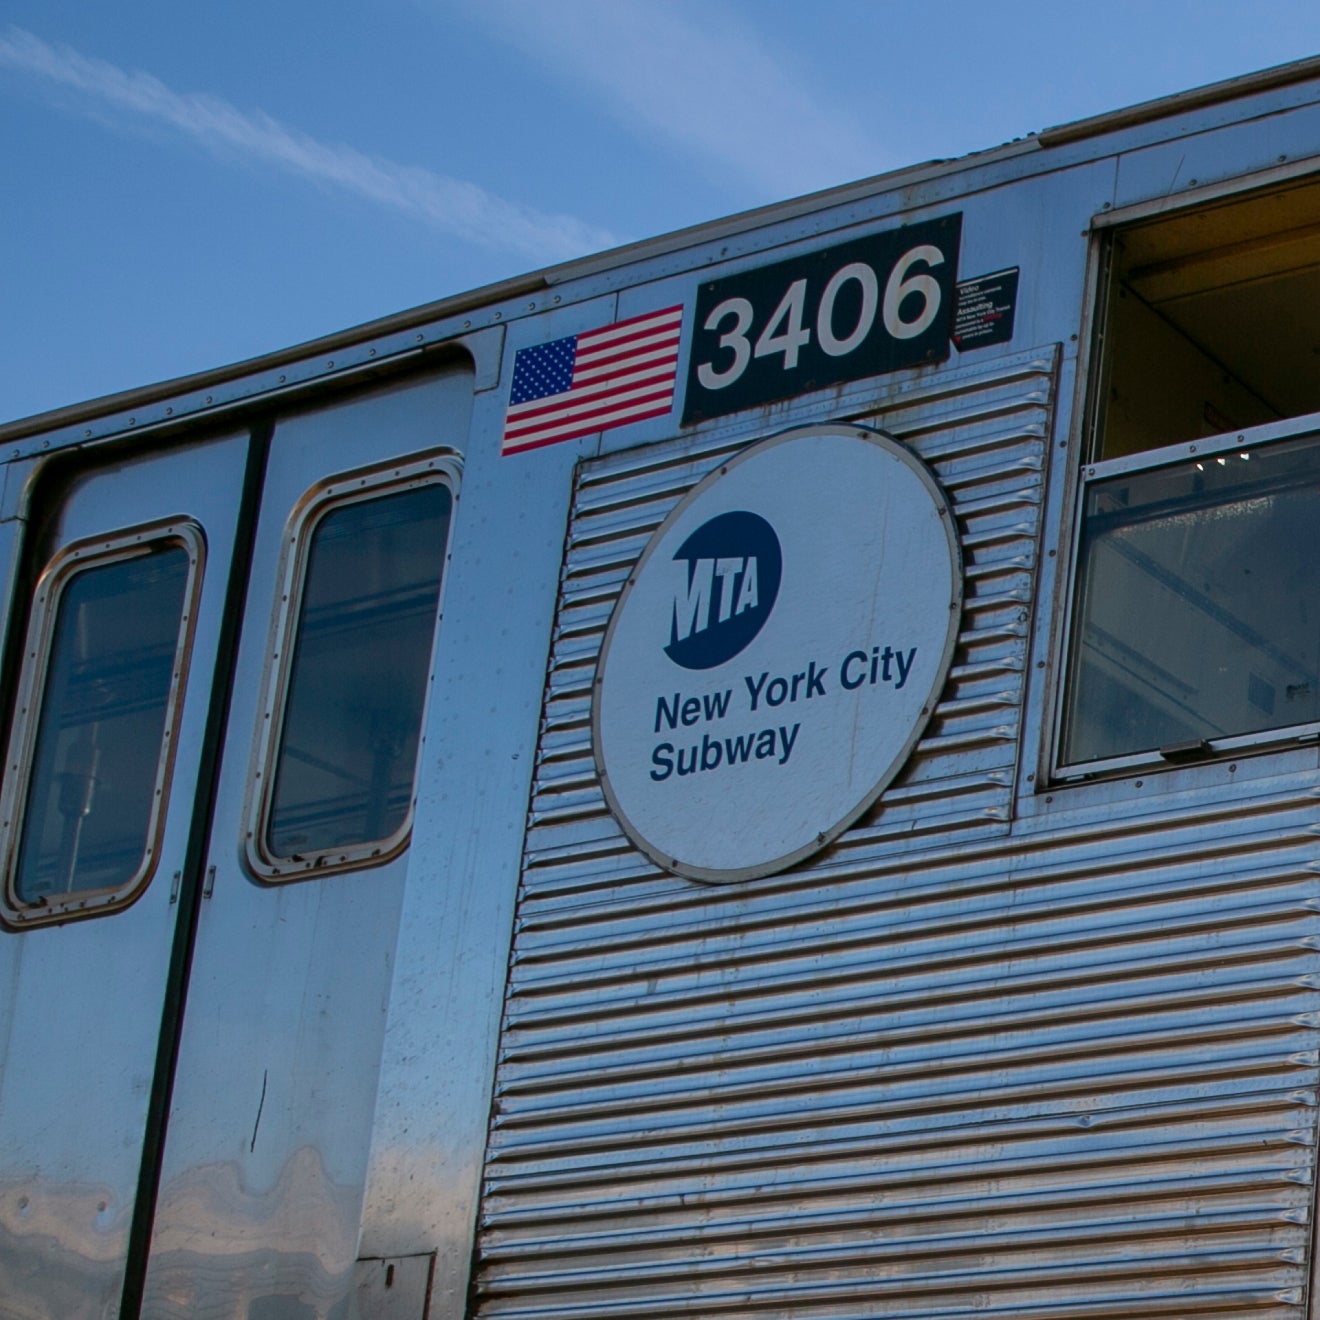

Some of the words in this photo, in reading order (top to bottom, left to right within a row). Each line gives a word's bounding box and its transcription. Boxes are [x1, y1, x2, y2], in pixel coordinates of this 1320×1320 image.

[697, 244, 945, 390] 3406
[664, 556, 758, 648] MTA
[654, 689, 733, 733] New
[744, 661, 829, 711] York
[840, 646, 918, 690] City
[649, 723, 801, 782] Subway
